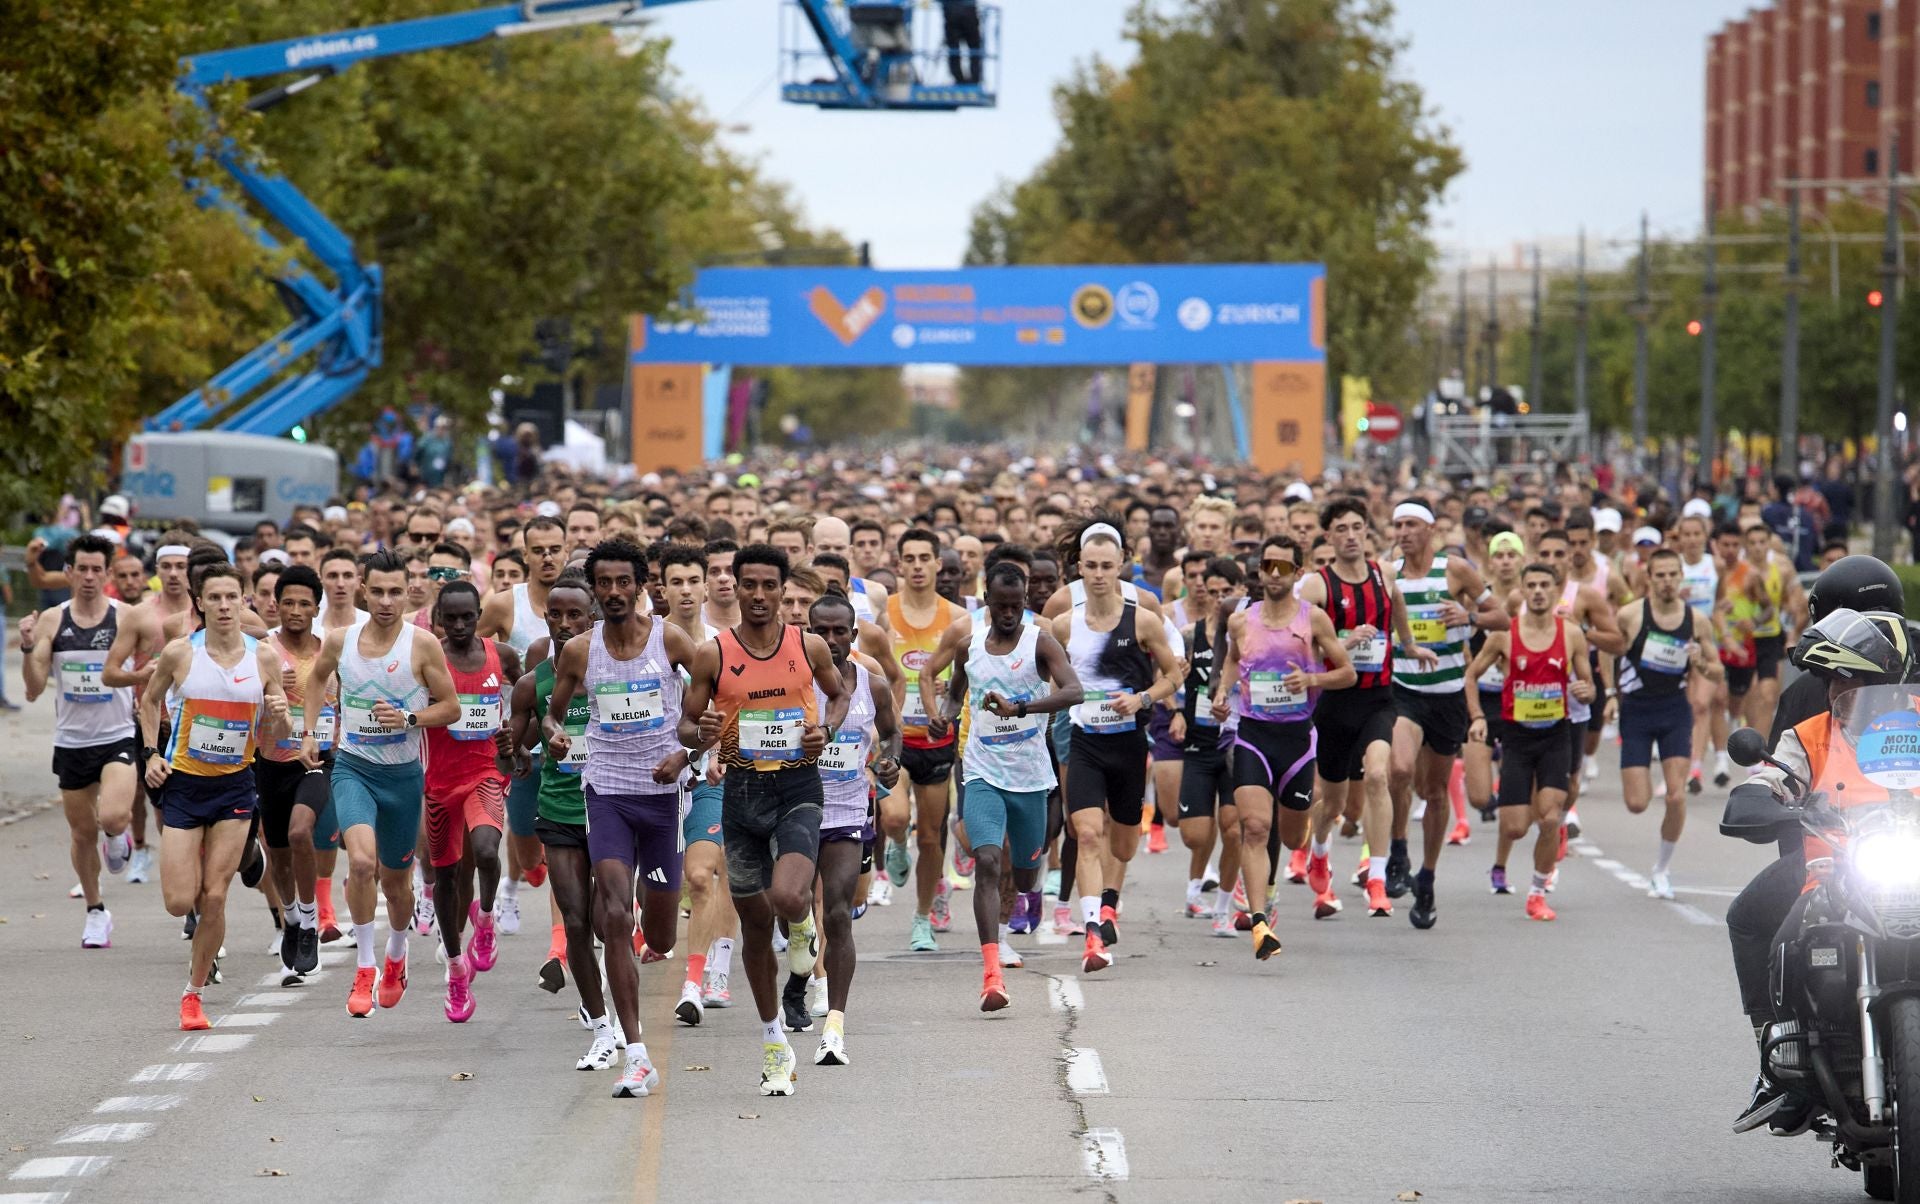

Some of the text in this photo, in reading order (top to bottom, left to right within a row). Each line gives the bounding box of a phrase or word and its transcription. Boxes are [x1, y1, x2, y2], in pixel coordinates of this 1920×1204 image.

[1216, 304, 1299, 324] ZURICH
[748, 688, 786, 700] VALENCIA
[625, 698, 631, 706] 1
[611, 710, 651, 720] KEJELCHA
[764, 725, 783, 734] 125
[994, 724, 1019, 733] ISMAIL
[1885, 735, 1917, 744] MOTO
[200, 743, 235, 753] ALMGREN
[829, 747, 840, 755] 13
[818, 759, 845, 768] BALEW
